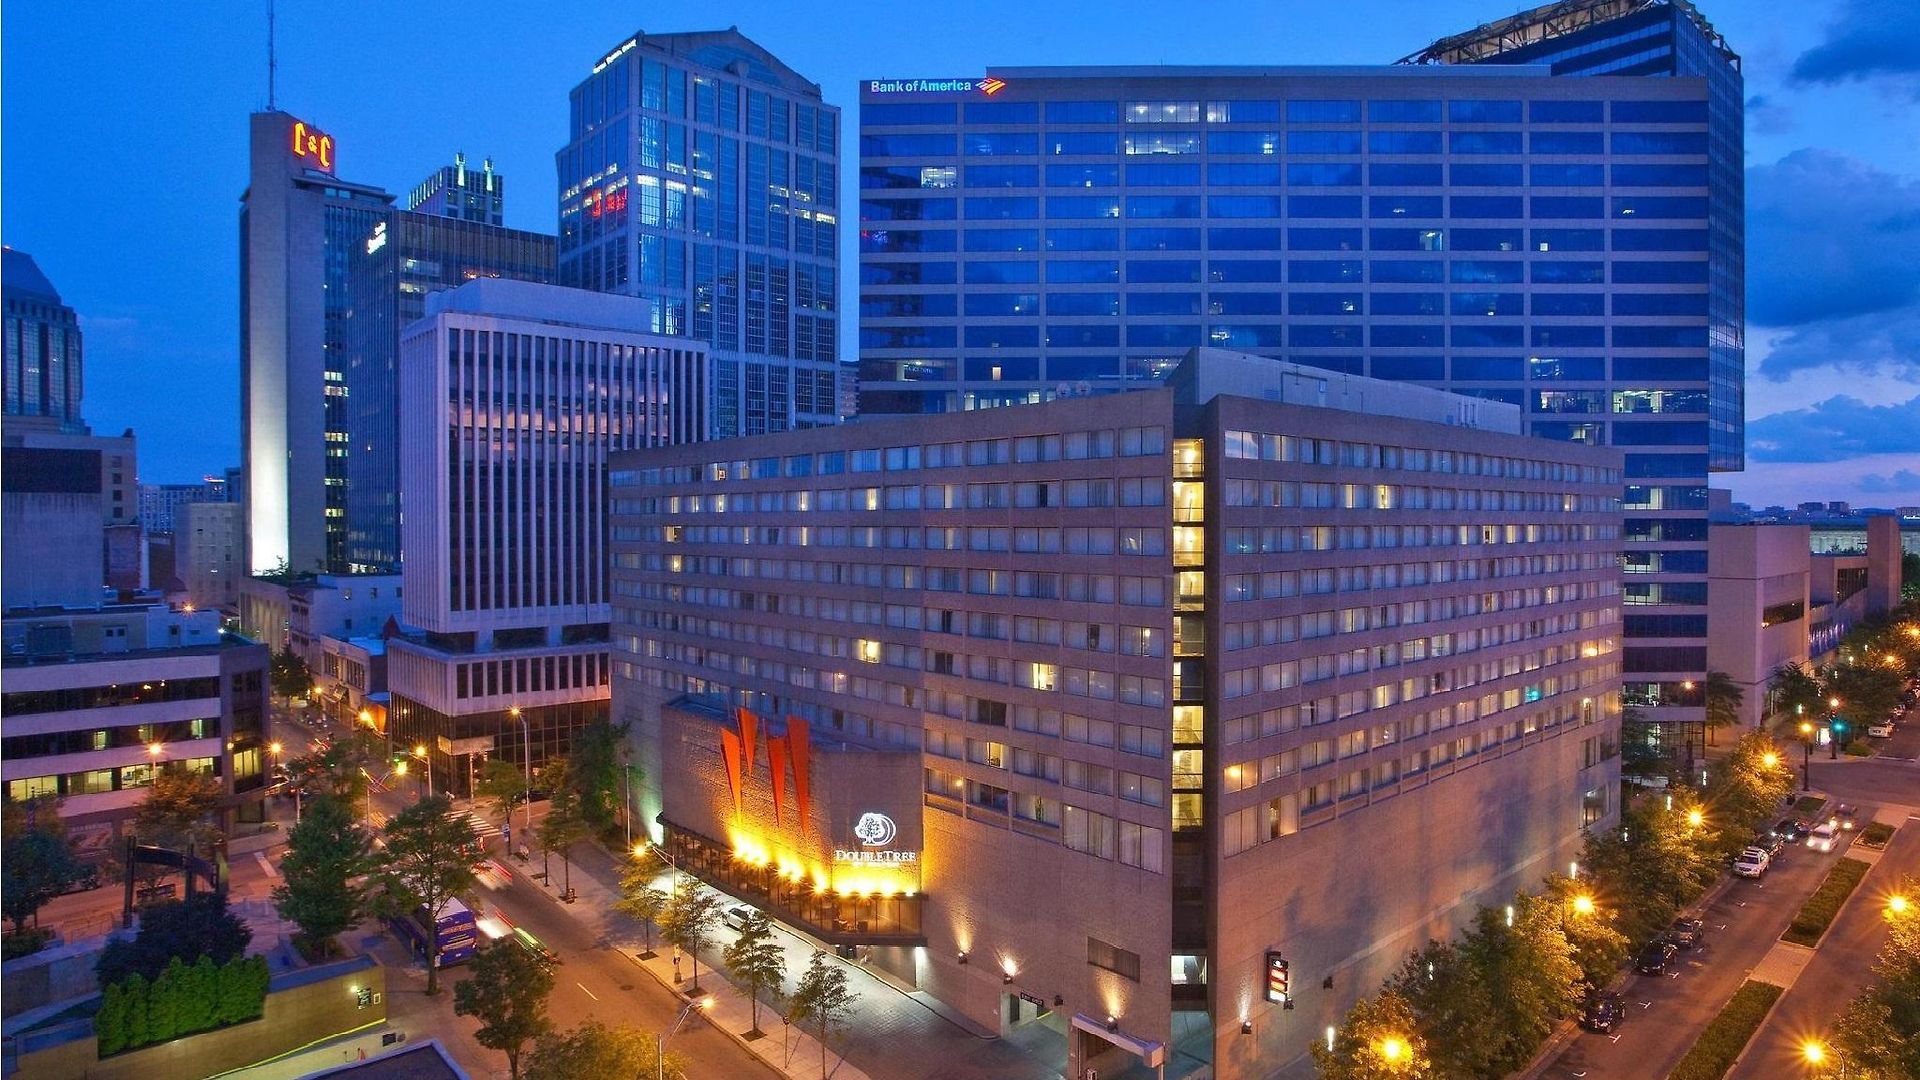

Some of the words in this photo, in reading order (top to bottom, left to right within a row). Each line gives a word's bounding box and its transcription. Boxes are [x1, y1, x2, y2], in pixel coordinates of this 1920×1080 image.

[871, 80, 903, 93] Bank
[905, 80, 919, 93] of
[919, 79, 972, 92] America
